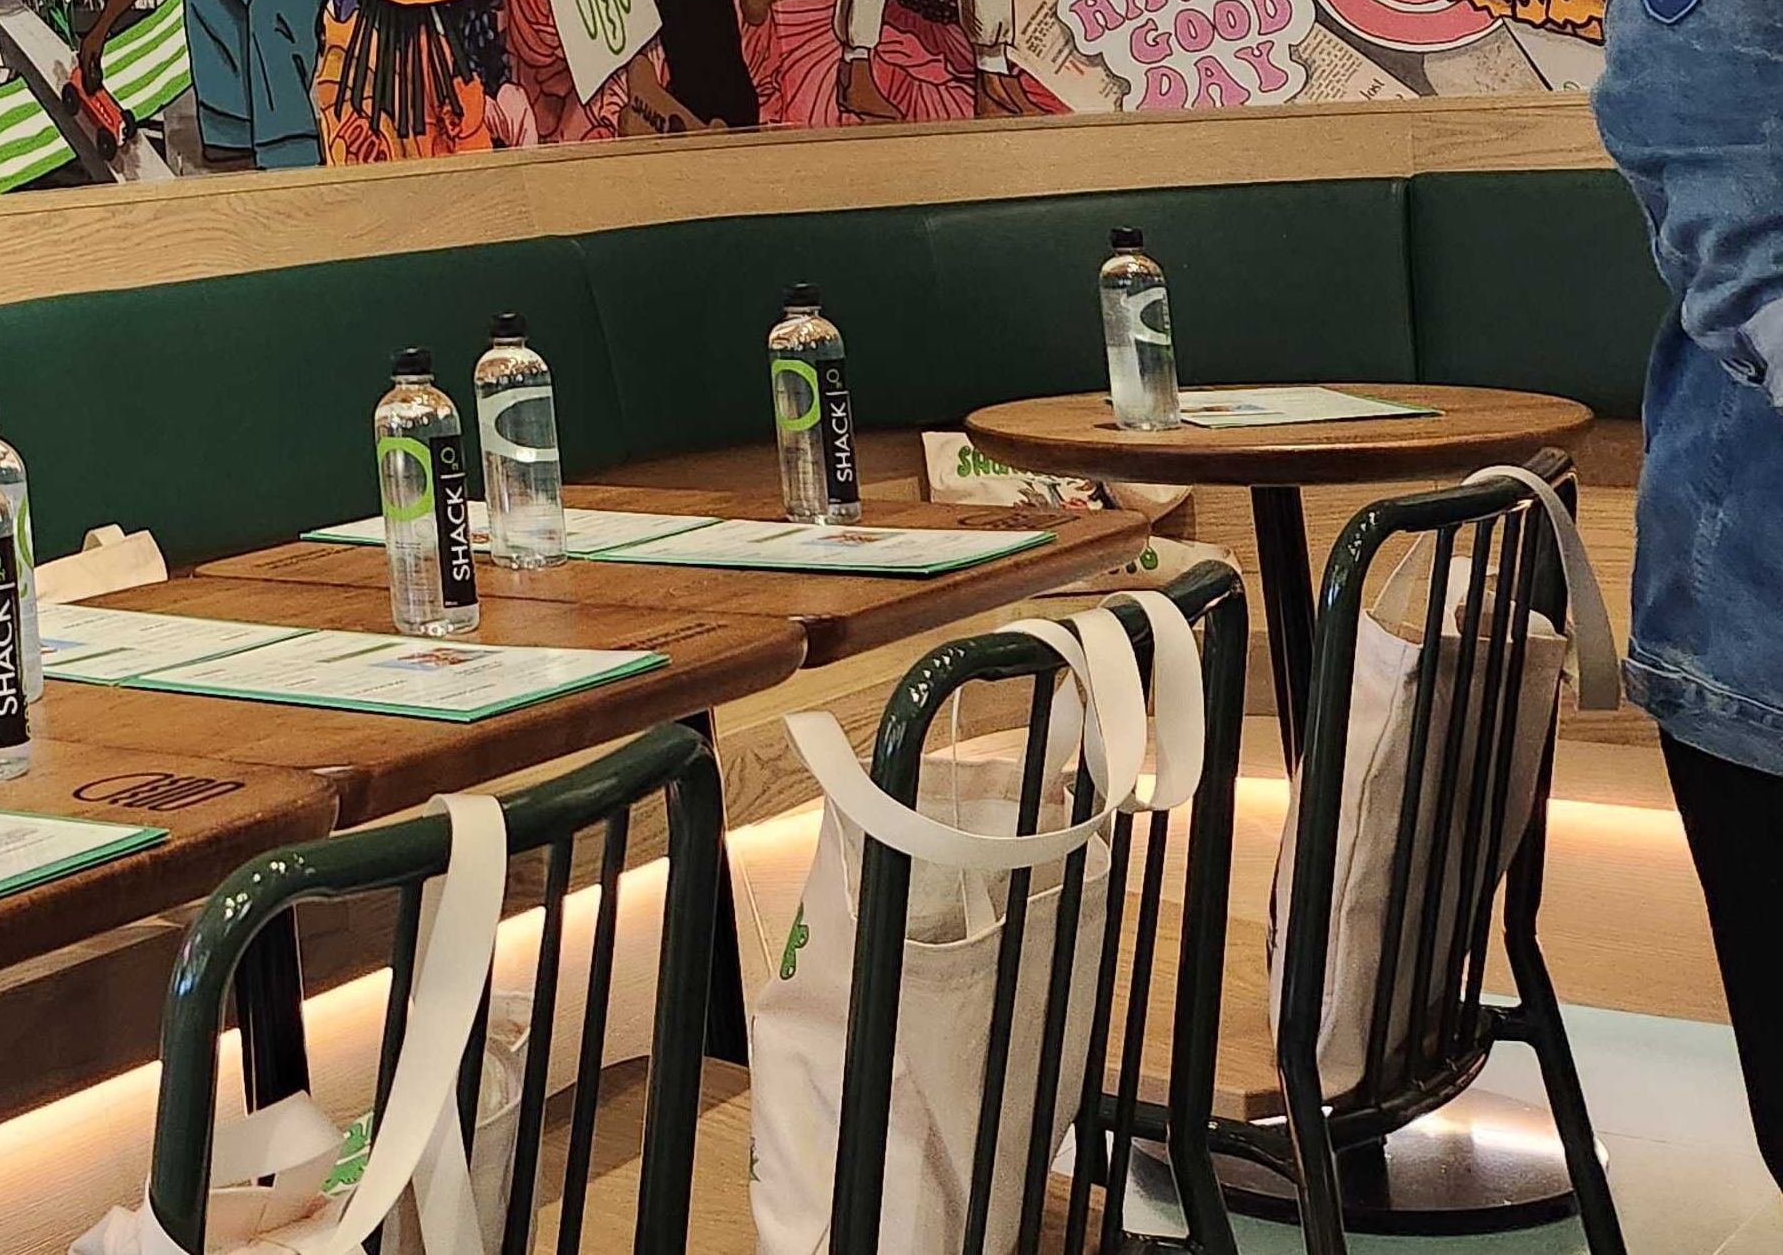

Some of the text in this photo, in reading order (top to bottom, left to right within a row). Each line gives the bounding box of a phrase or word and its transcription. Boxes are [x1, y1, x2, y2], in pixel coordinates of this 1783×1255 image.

[1138, 41, 1290, 110] DAY
[829, 401, 854, 483] SHACK
[444, 485, 472, 583] SHACK
